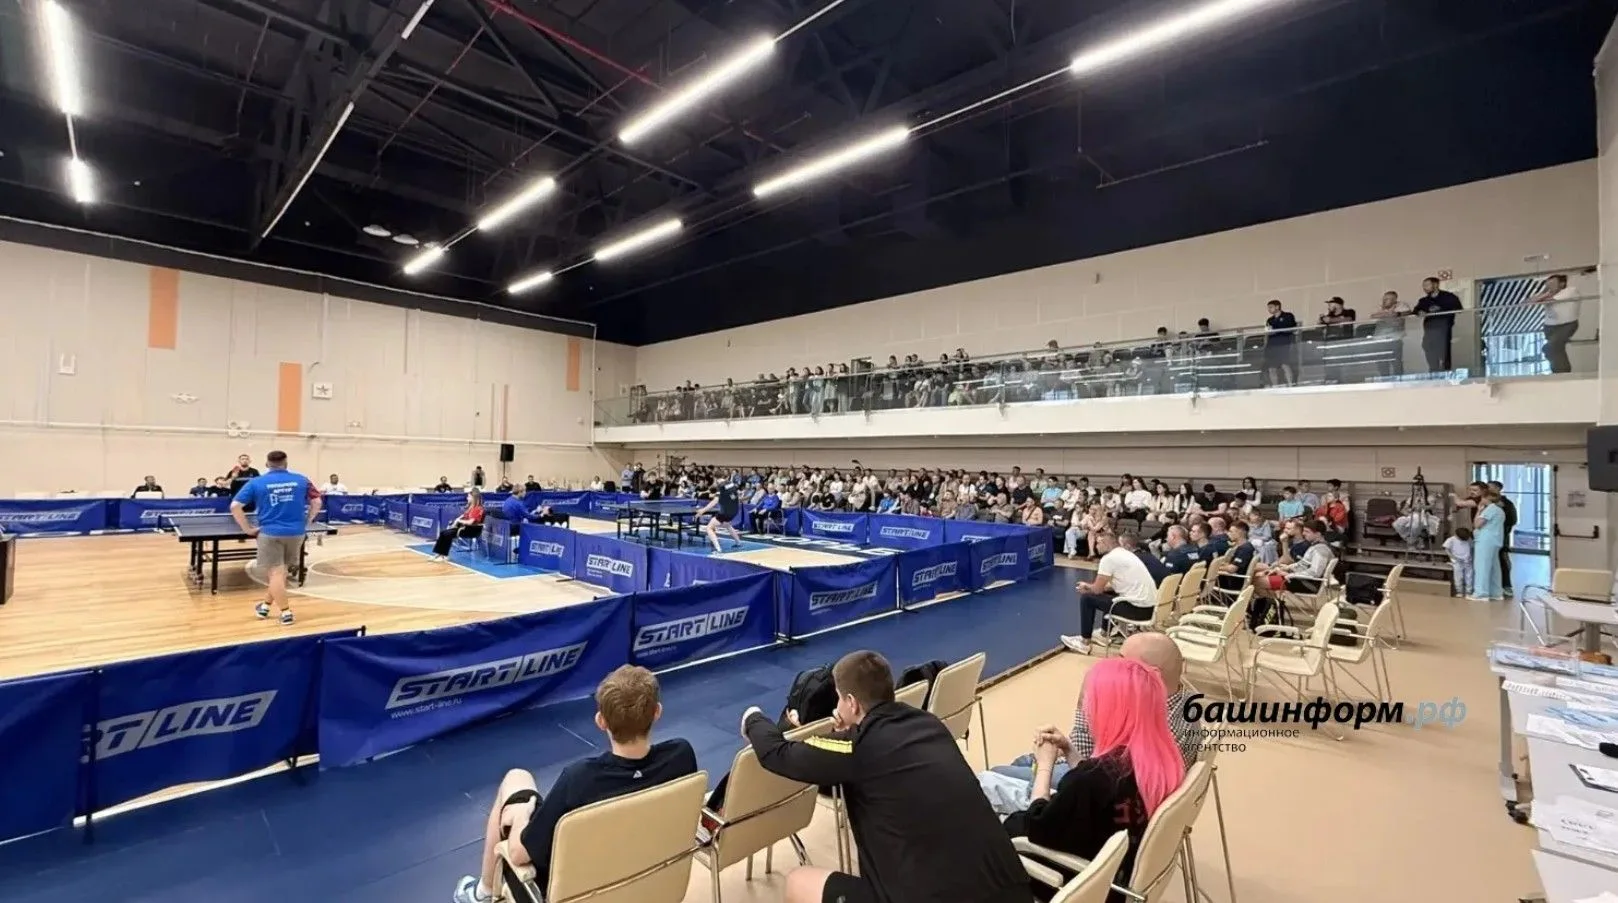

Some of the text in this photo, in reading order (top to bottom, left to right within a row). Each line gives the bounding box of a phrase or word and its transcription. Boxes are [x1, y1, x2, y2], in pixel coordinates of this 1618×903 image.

[611, 560, 631, 575] LINE
[638, 609, 745, 646] START LINE
[395, 647, 581, 701] START LINE
[154, 698, 262, 738] LINE
